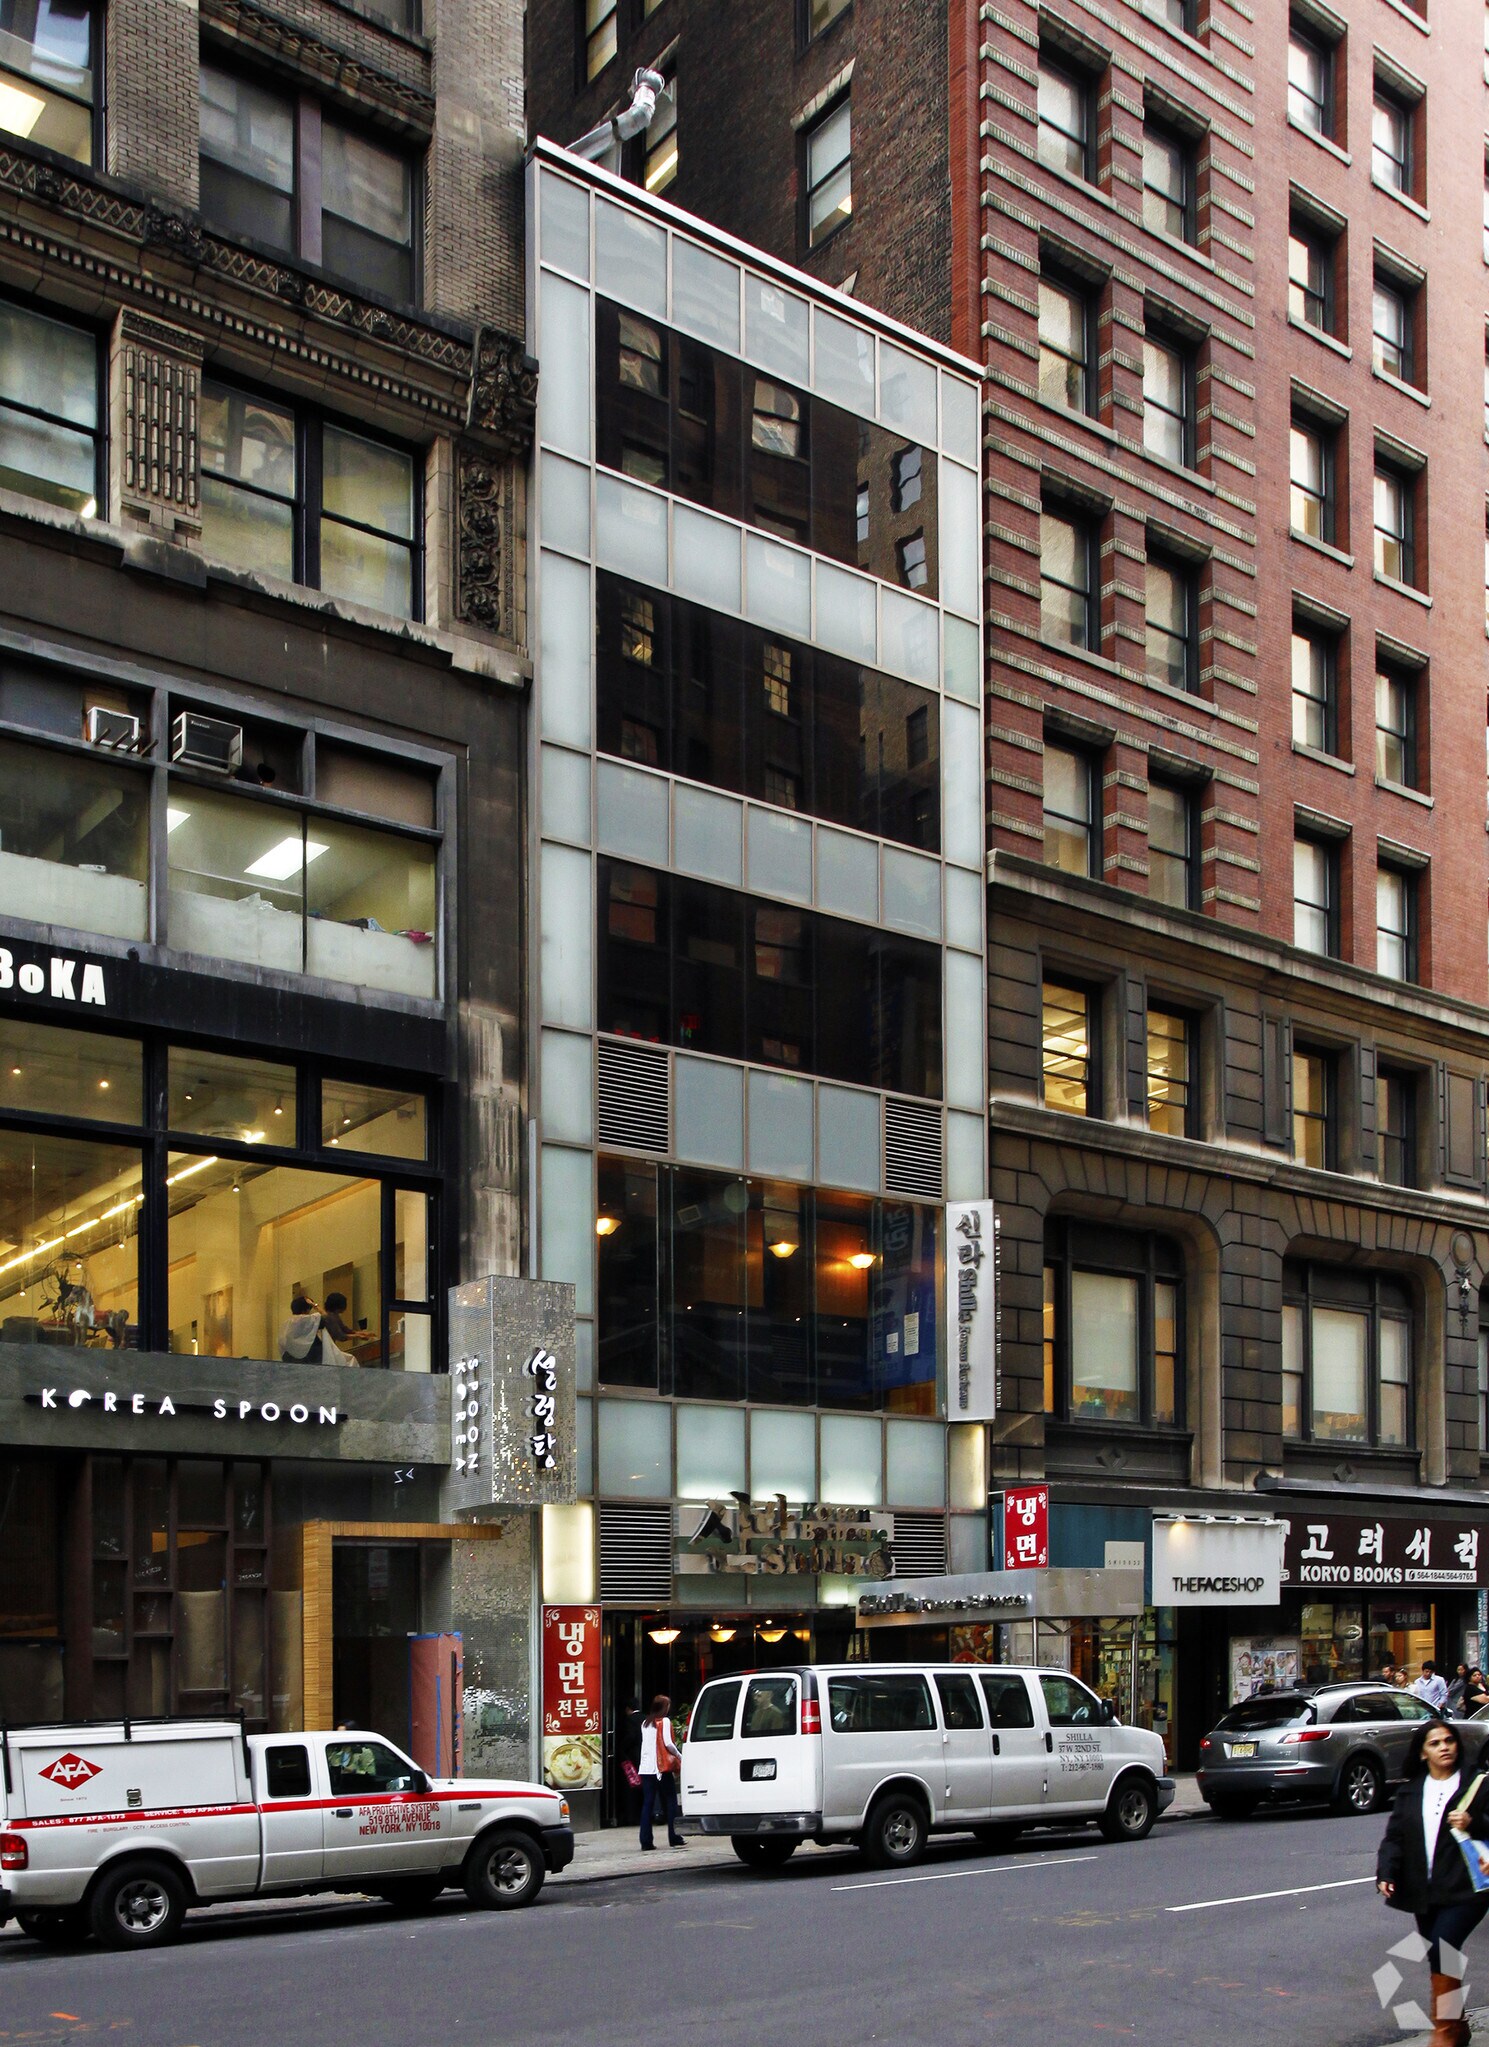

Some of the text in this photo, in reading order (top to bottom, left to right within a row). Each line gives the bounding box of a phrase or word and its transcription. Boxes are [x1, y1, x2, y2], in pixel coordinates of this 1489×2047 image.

[955, 1210, 985, 1269] 신라
[213, 1399, 338, 1425] SPOON
[467, 1358, 479, 1469] SPOON
[531, 1350, 557, 1468] 설렁탕
[802, 1502, 871, 1523] Korean
[800, 1520, 888, 1543] Barbecue
[1016, 1496, 1037, 1562] 냉면
[761, 1543, 866, 1576] Shilla
[1300, 1565, 1351, 1582] KORYO
[1354, 1566, 1403, 1583] BOOKS
[1417, 1571, 1474, 1581] 564-1844/564-9765
[1172, 1577, 1265, 1593] THEFACESHOP
[558, 1623, 585, 1694] 냉면
[557, 1699, 589, 1718] 전문
[1066, 1733, 1093, 1741] SHILLA
[1075, 1744, 1091, 1752] 32ND
[50, 1760, 93, 1782] AFA
[144, 1809, 180, 1817] SERVICE:
[359, 1803, 440, 1816] AFA PROTECTIVE SYSTEMS
[369, 1812, 431, 1826] 519 8TH AVENUE
[32, 1818, 64, 1826] SALES:
[359, 1825, 377, 1835] NEW
[406, 1822, 416, 1832] NY
[418, 1820, 440, 1831] 10018
